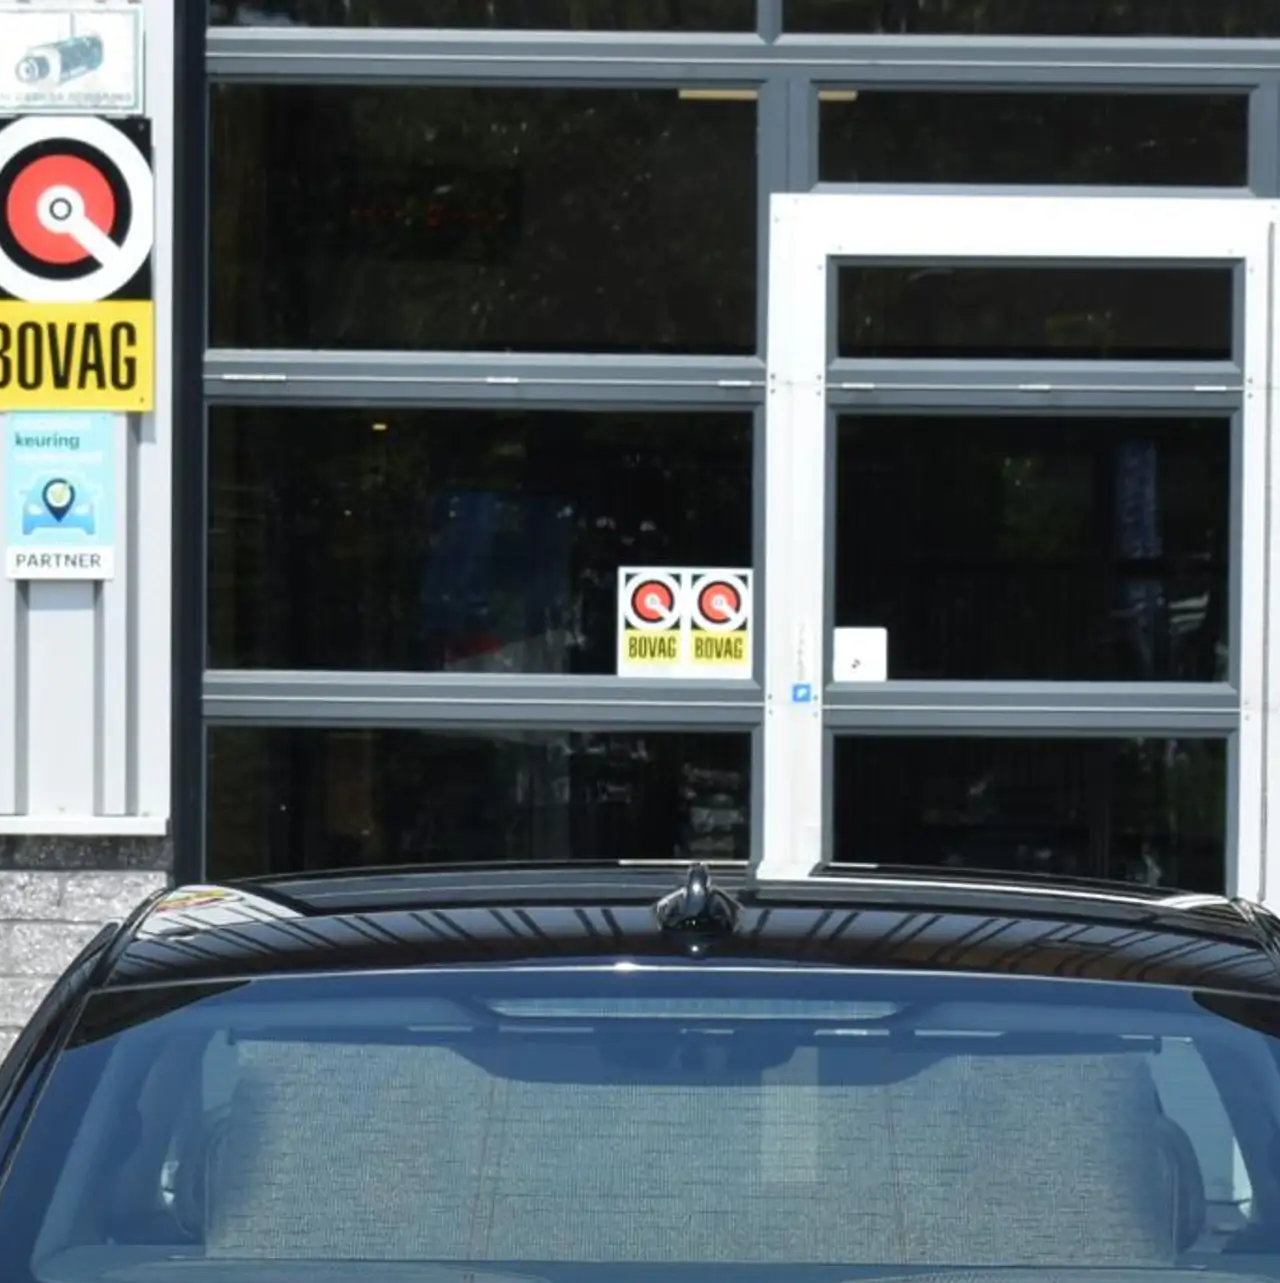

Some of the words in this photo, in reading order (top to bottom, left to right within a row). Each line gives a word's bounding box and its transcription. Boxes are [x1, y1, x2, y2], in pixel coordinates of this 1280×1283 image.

[14, 432, 80, 450] keuring
[15, 553, 102, 568] PARTNER
[628, 636, 677, 659] BOVAG
[694, 637, 743, 660] BOVAG
